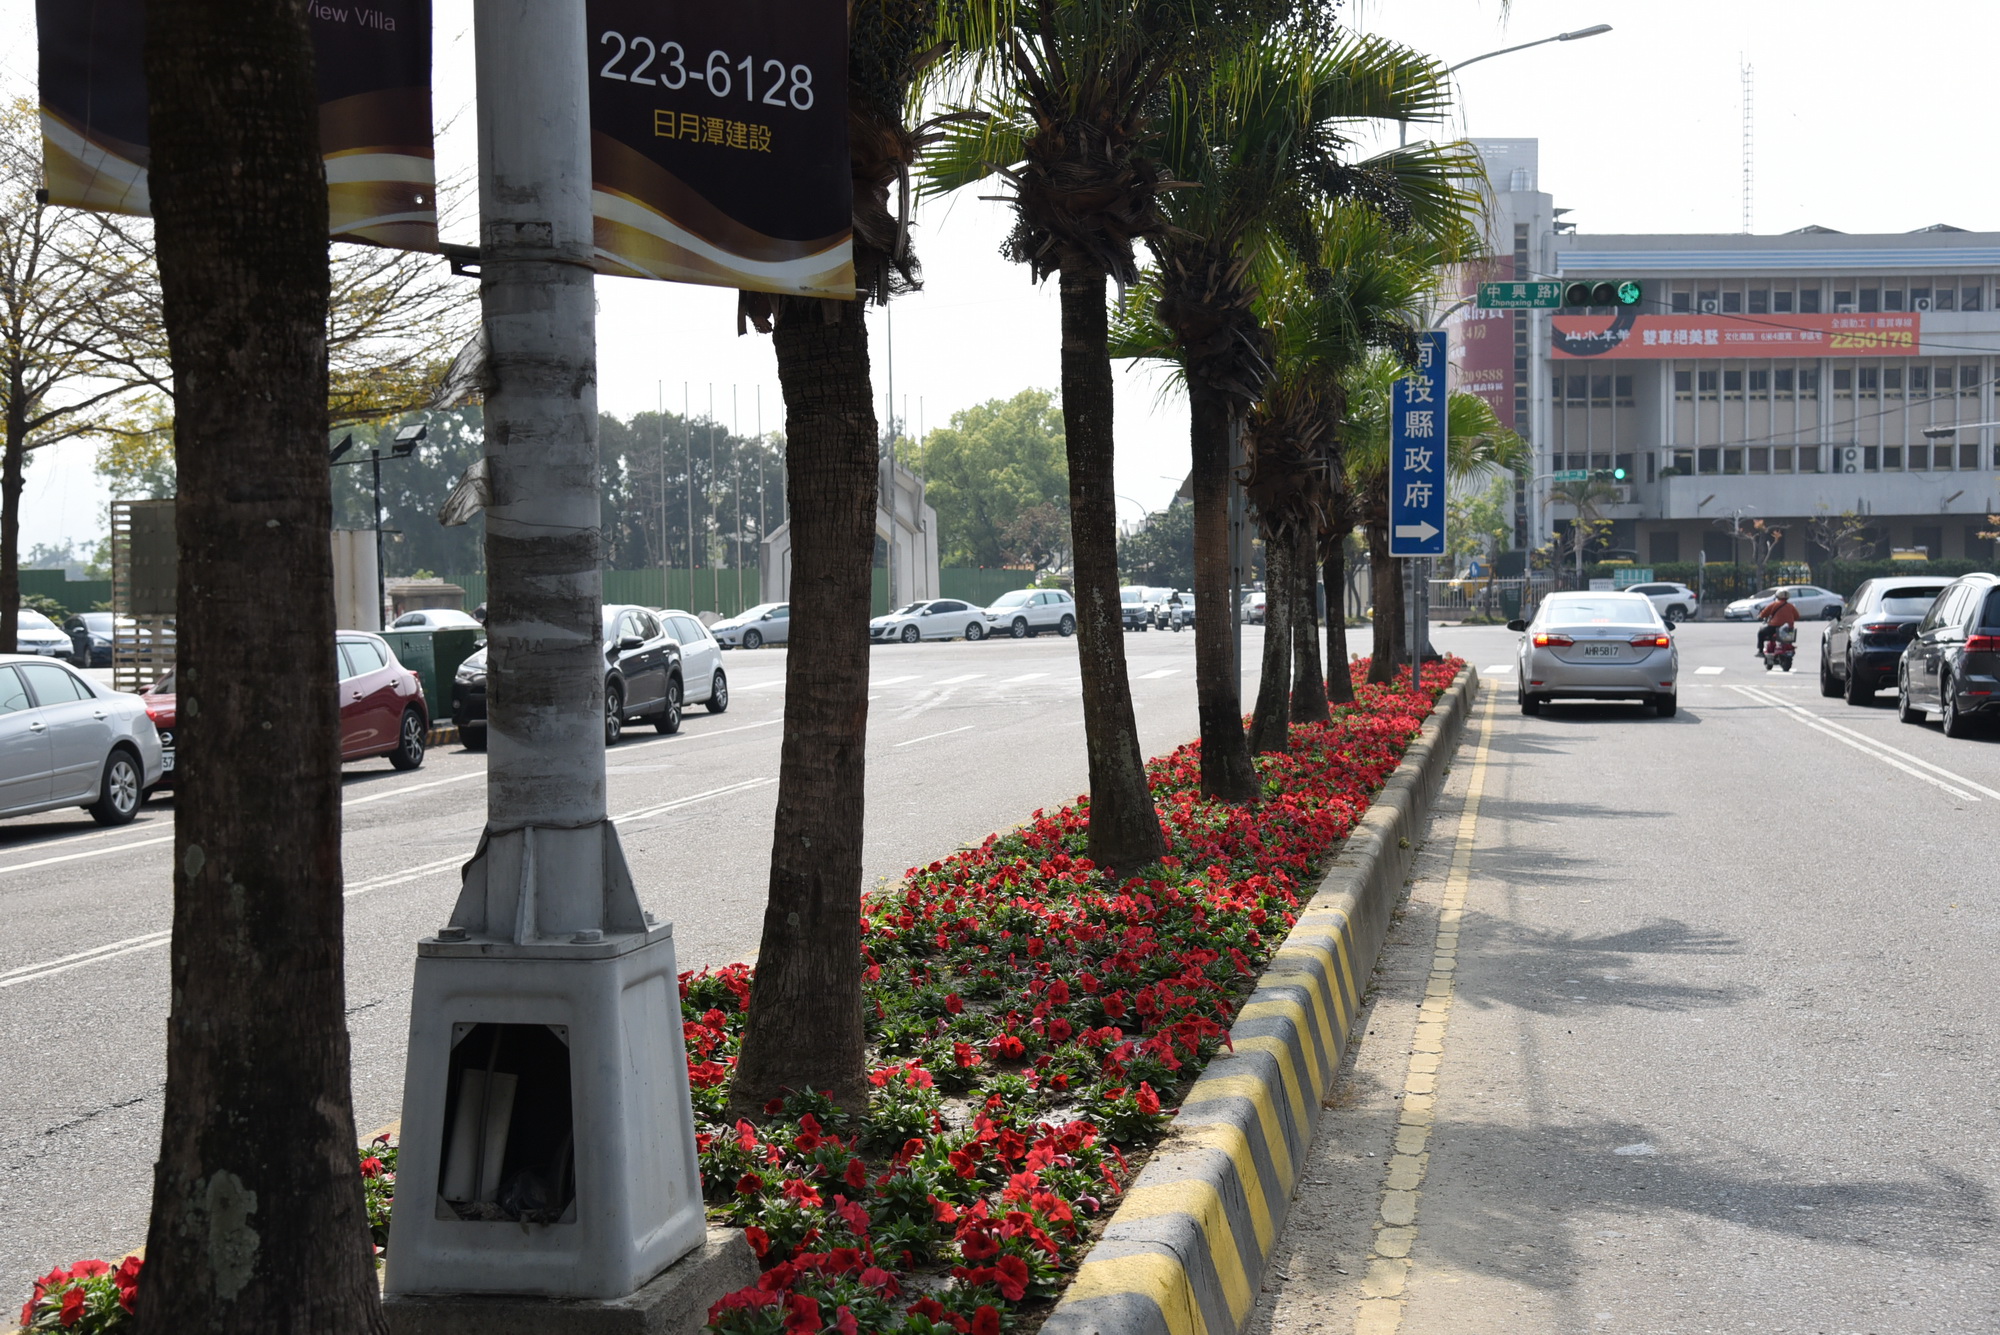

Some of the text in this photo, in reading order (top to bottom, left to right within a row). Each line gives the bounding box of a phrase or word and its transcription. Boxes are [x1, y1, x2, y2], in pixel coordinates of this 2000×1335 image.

[355, 7, 396, 31] Villa
[600, 30, 815, 111] 223-6128
[654, 108, 772, 153] 日月潭建設
[1487, 284, 1552, 299] 中興路
[1490, 298, 1547, 307] Zhongxing Rd.
[1642, 328, 1719, 346] 雙車絕美墅
[1829, 331, 1913, 349] 2250178
